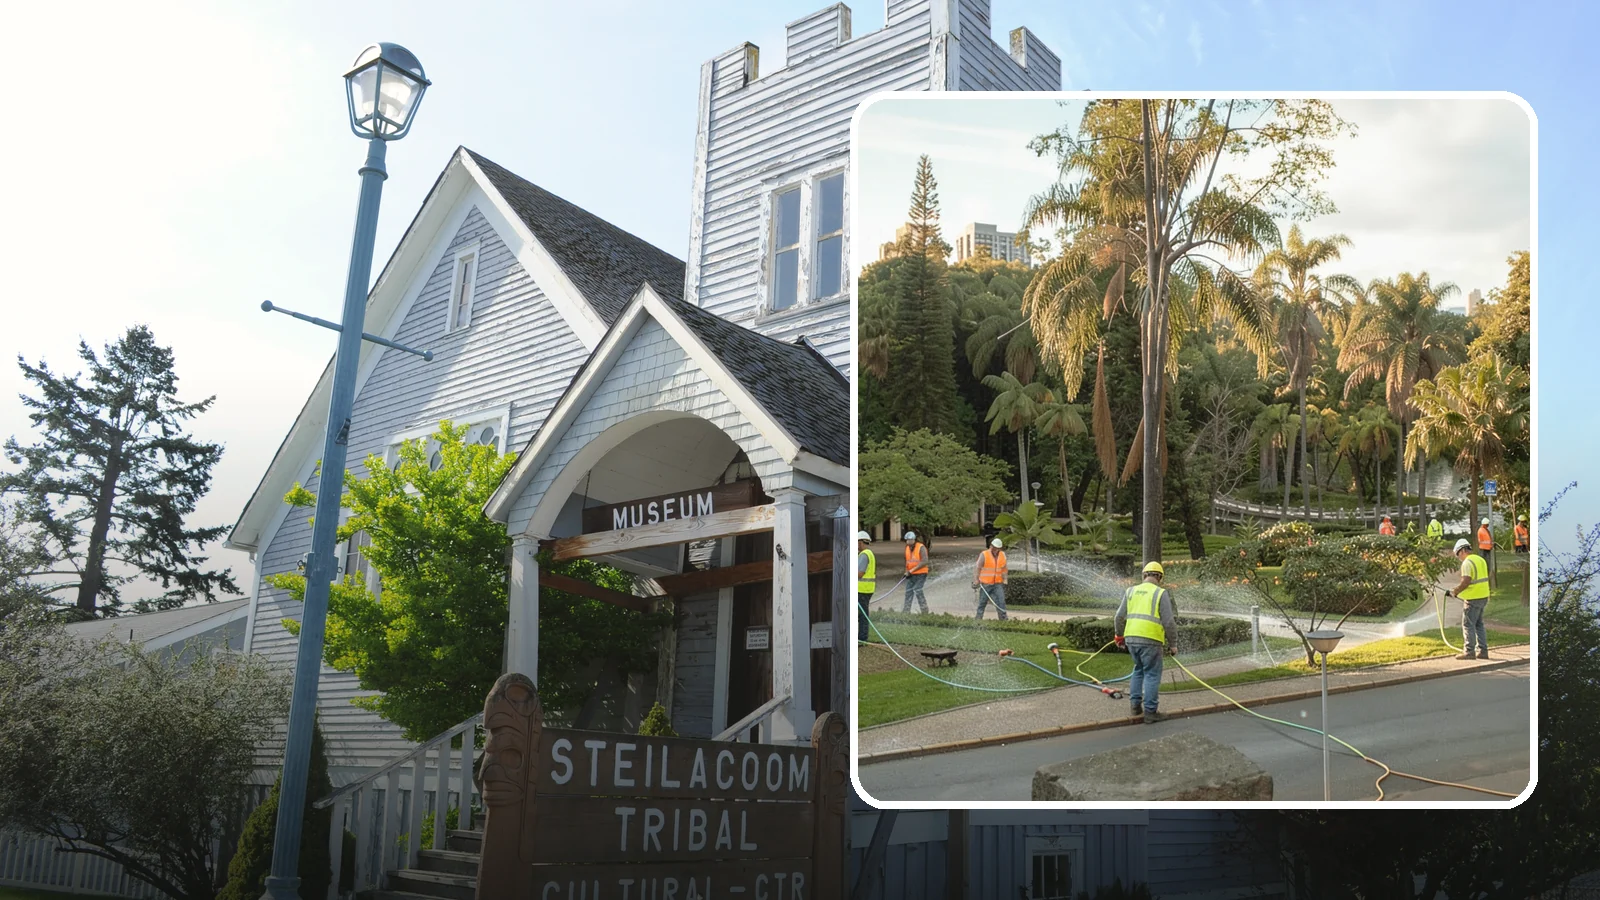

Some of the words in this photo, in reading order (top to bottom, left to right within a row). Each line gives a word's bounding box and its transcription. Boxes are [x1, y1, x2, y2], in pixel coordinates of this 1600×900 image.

[613, 491, 713, 530] MUSEUM
[550, 738, 809, 792] STEILACOOM
[615, 807, 758, 851] TRIBAL
